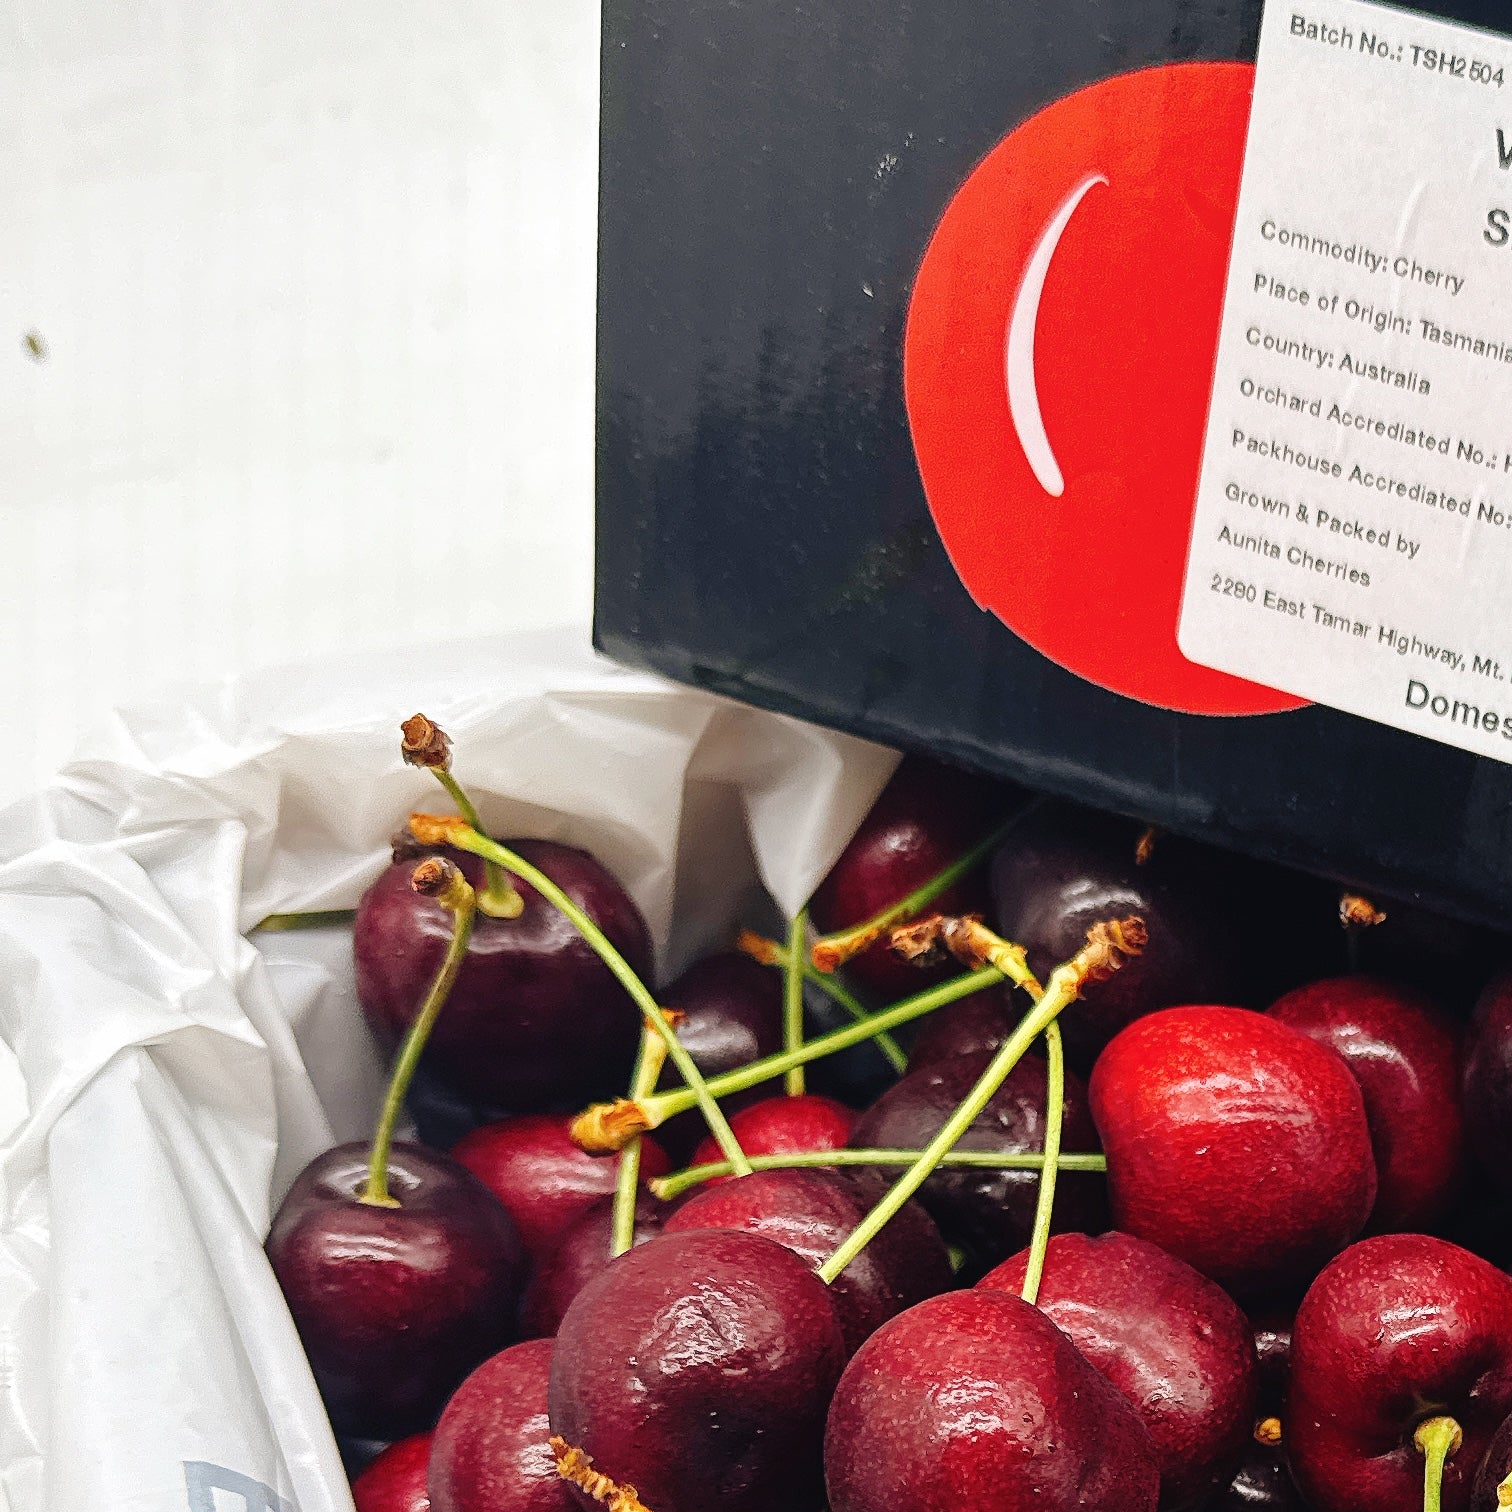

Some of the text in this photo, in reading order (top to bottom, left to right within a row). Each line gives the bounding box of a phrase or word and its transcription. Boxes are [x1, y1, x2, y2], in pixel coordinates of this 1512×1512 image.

[1288, 12, 1505, 88] Batch No.: TSH2504
[1259, 218, 1465, 296] Commodity: Cherry
[1252, 271, 1310, 306] Place
[1316, 293, 1340, 314] of
[1343, 298, 1412, 335] Origin:
[1244, 325, 1431, 396] Country: Australia
[1238, 376, 1322, 418] Orchard
[1325, 401, 1451, 455] Accrediated
[1455, 438, 1498, 470] No.:
[1231, 427, 1343, 478] Packhouse
[1346, 463, 1472, 517] Accrediated
[1475, 500, 1512, 530] No:
[1216, 523, 1371, 587] Aunita Cherries
[1223, 480, 1421, 560] Grown & Packed by
[1262, 588, 1306, 619] East
[1311, 602, 1372, 638] Tamar
[1376, 624, 1466, 672] Highway,
[1470, 653, 1504, 681] Mt.
